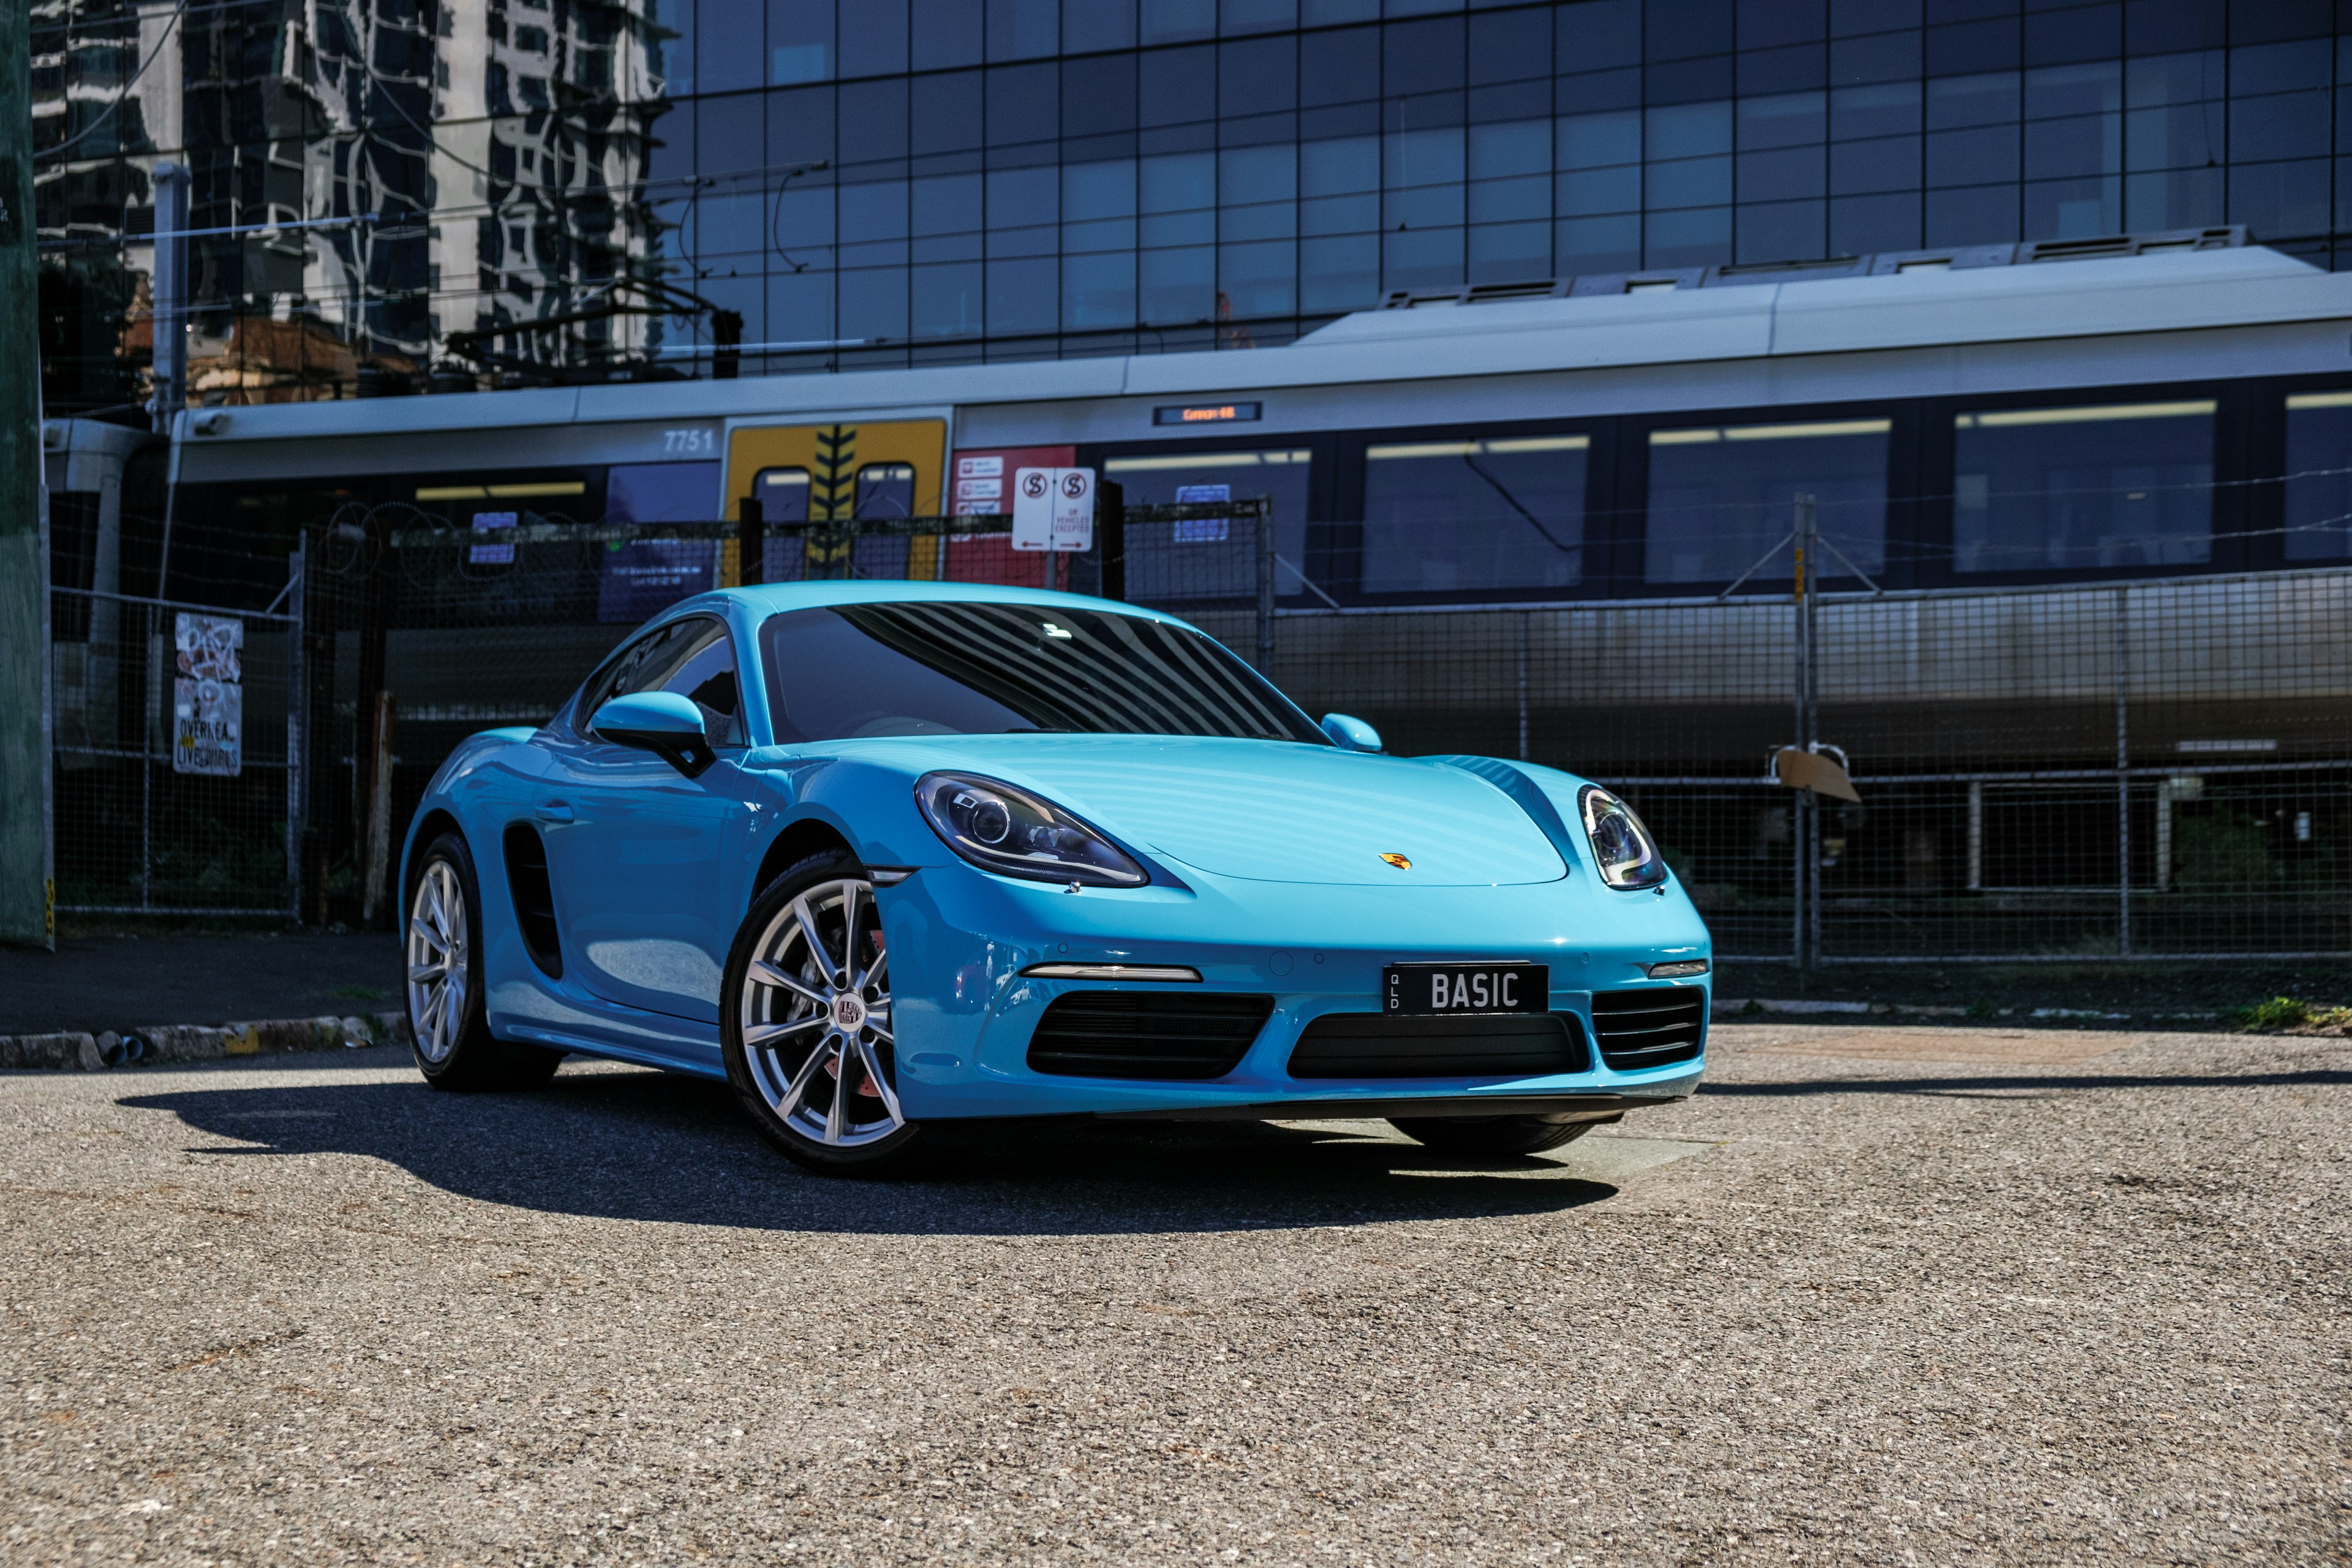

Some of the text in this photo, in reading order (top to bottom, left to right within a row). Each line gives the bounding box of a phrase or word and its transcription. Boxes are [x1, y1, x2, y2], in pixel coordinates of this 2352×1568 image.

[665, 430, 713, 451] 7751
[181, 718, 235, 742] OVERHEA
[1432, 973, 1519, 1008] BASIC
